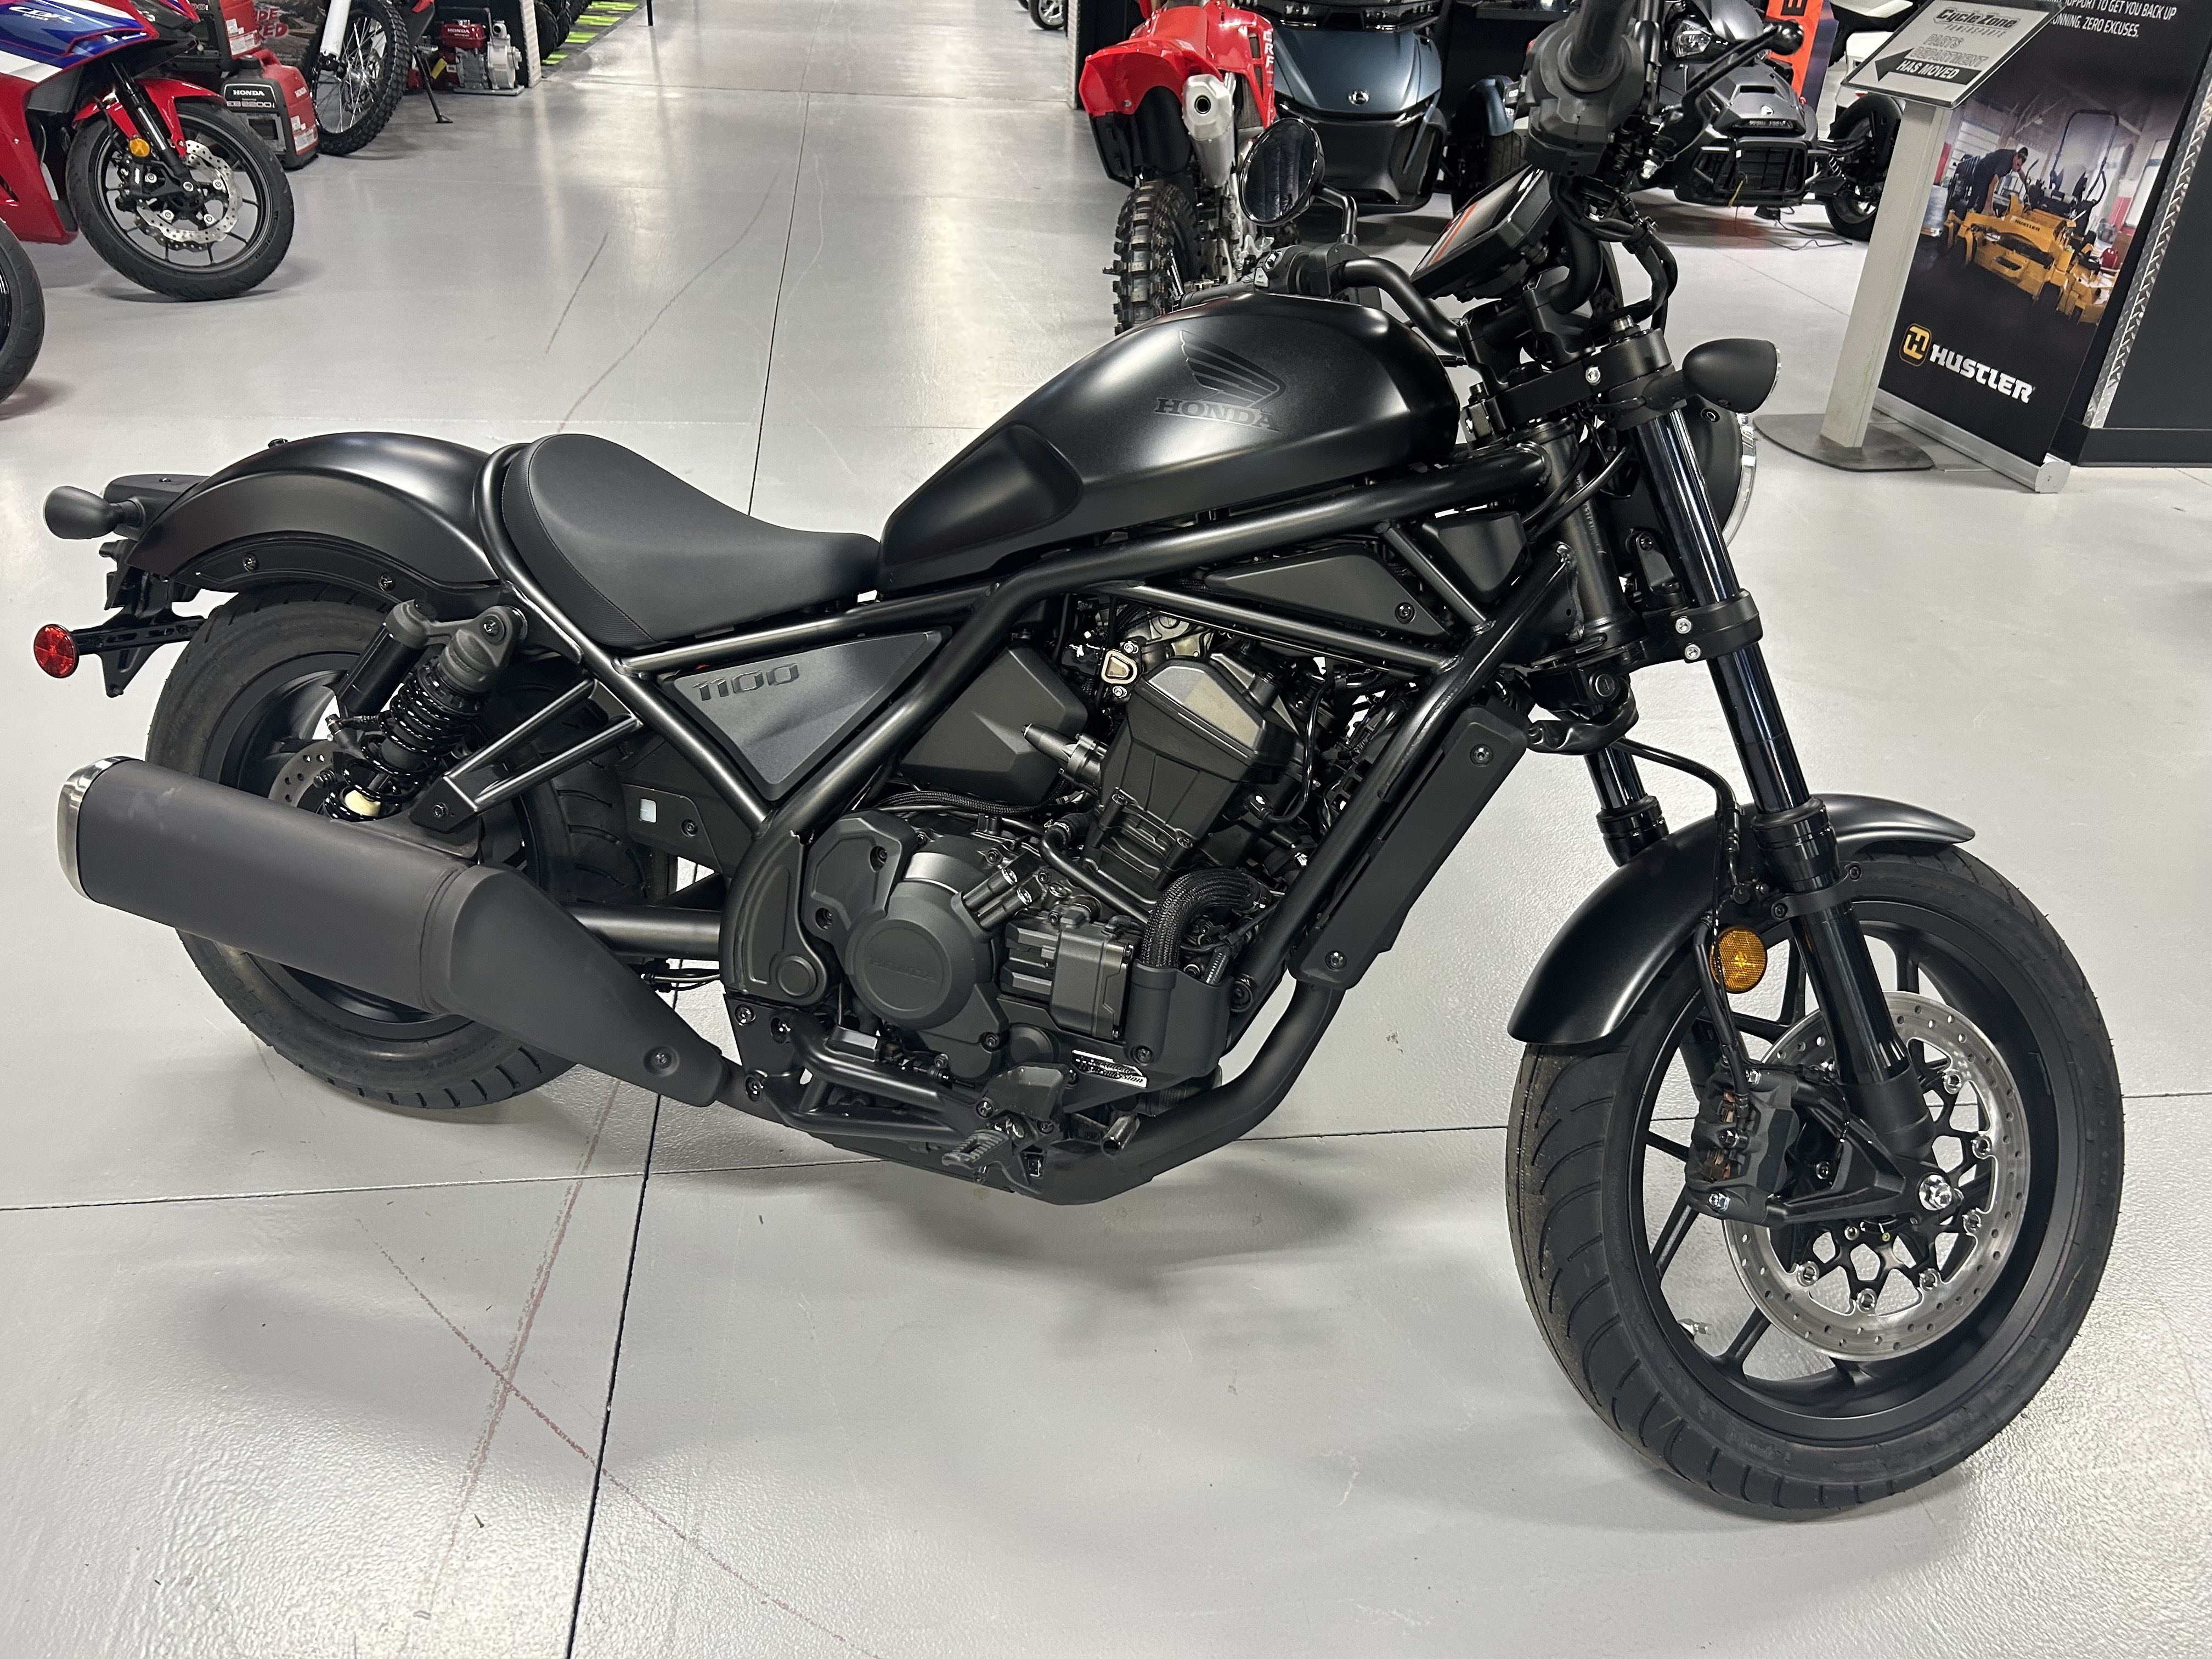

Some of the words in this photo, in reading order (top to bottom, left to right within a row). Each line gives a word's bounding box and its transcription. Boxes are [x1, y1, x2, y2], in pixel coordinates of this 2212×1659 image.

[2065, 0, 2095, 9] UPPORT
[2108, 0, 2123, 13] GET
[2124, 1, 2141, 16] YOU
[2141, 3, 2163, 19] BACK
[2164, 7, 2177, 20] UP
[2050, 13, 2081, 29] UNNING.
[2083, 16, 2104, 32] ZERO
[2103, 20, 2140, 37] EXCUSES.
[1263, 30, 1274, 68] CRF
[1923, 34, 1963, 48] PARTS
[1910, 46, 1989, 67] DEPARTMENT
[1896, 60, 1922, 72] HAS
[1918, 64, 1960, 79] MOVED
[1929, 344, 2033, 403] HUSTLER
[1154, 398, 1279, 432] HONDA
[692, 662, 799, 701] 1100
